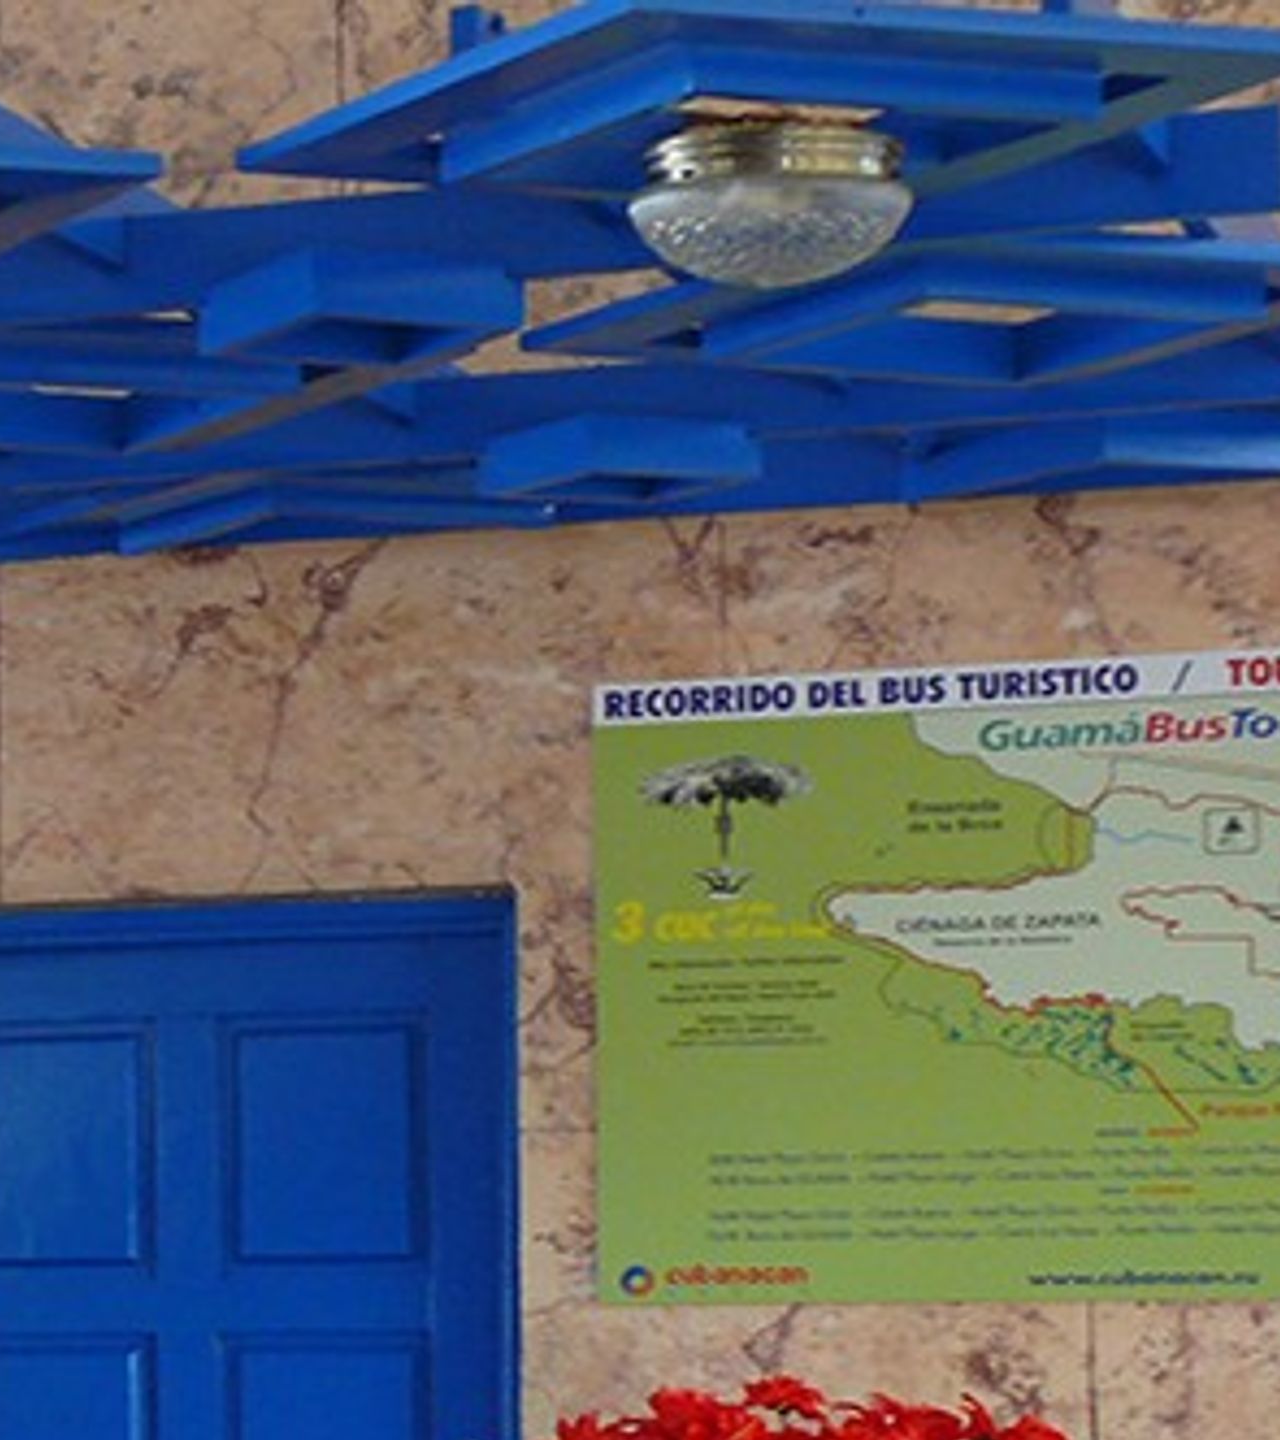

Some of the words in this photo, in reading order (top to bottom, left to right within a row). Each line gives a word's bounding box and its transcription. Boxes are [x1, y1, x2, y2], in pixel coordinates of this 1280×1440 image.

[603, 682, 795, 719] RECORRIDO
[807, 680, 866, 709] DEL
[880, 674, 947, 705] BUS
[957, 663, 1139, 700] TURISTICO
